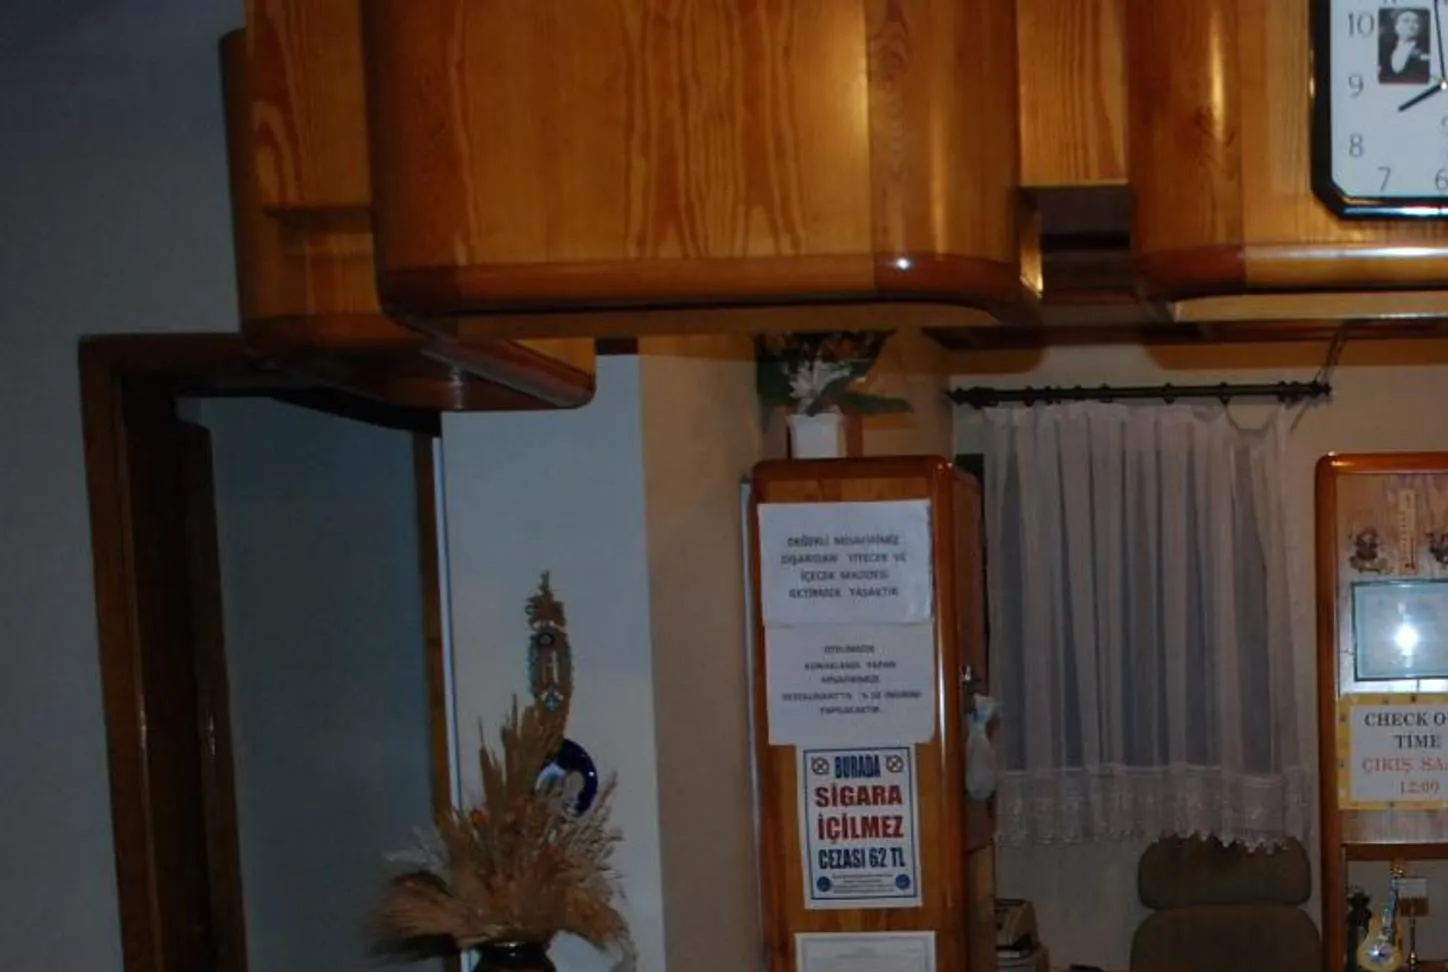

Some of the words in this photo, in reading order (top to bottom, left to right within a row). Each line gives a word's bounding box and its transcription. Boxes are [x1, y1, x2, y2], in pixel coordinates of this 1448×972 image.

[1347, 13, 1375, 38] 10
[1348, 74, 1364, 99] 9
[1349, 133, 1364, 158] 8
[1377, 166, 1391, 191] 7
[1364, 711, 1429, 728] CHECK
[834, 755, 881, 778] BURADA
[1361, 758, 1413, 776] ÇIKIŞ
[814, 784, 903, 808] SİGARA
[1399, 781, 1439, 794] 12:00
[817, 815, 905, 844] İÇİLMEZ
[818, 849, 866, 870] CEZASI
[869, 848, 886, 869] 62
[889, 847, 906, 868] TL
